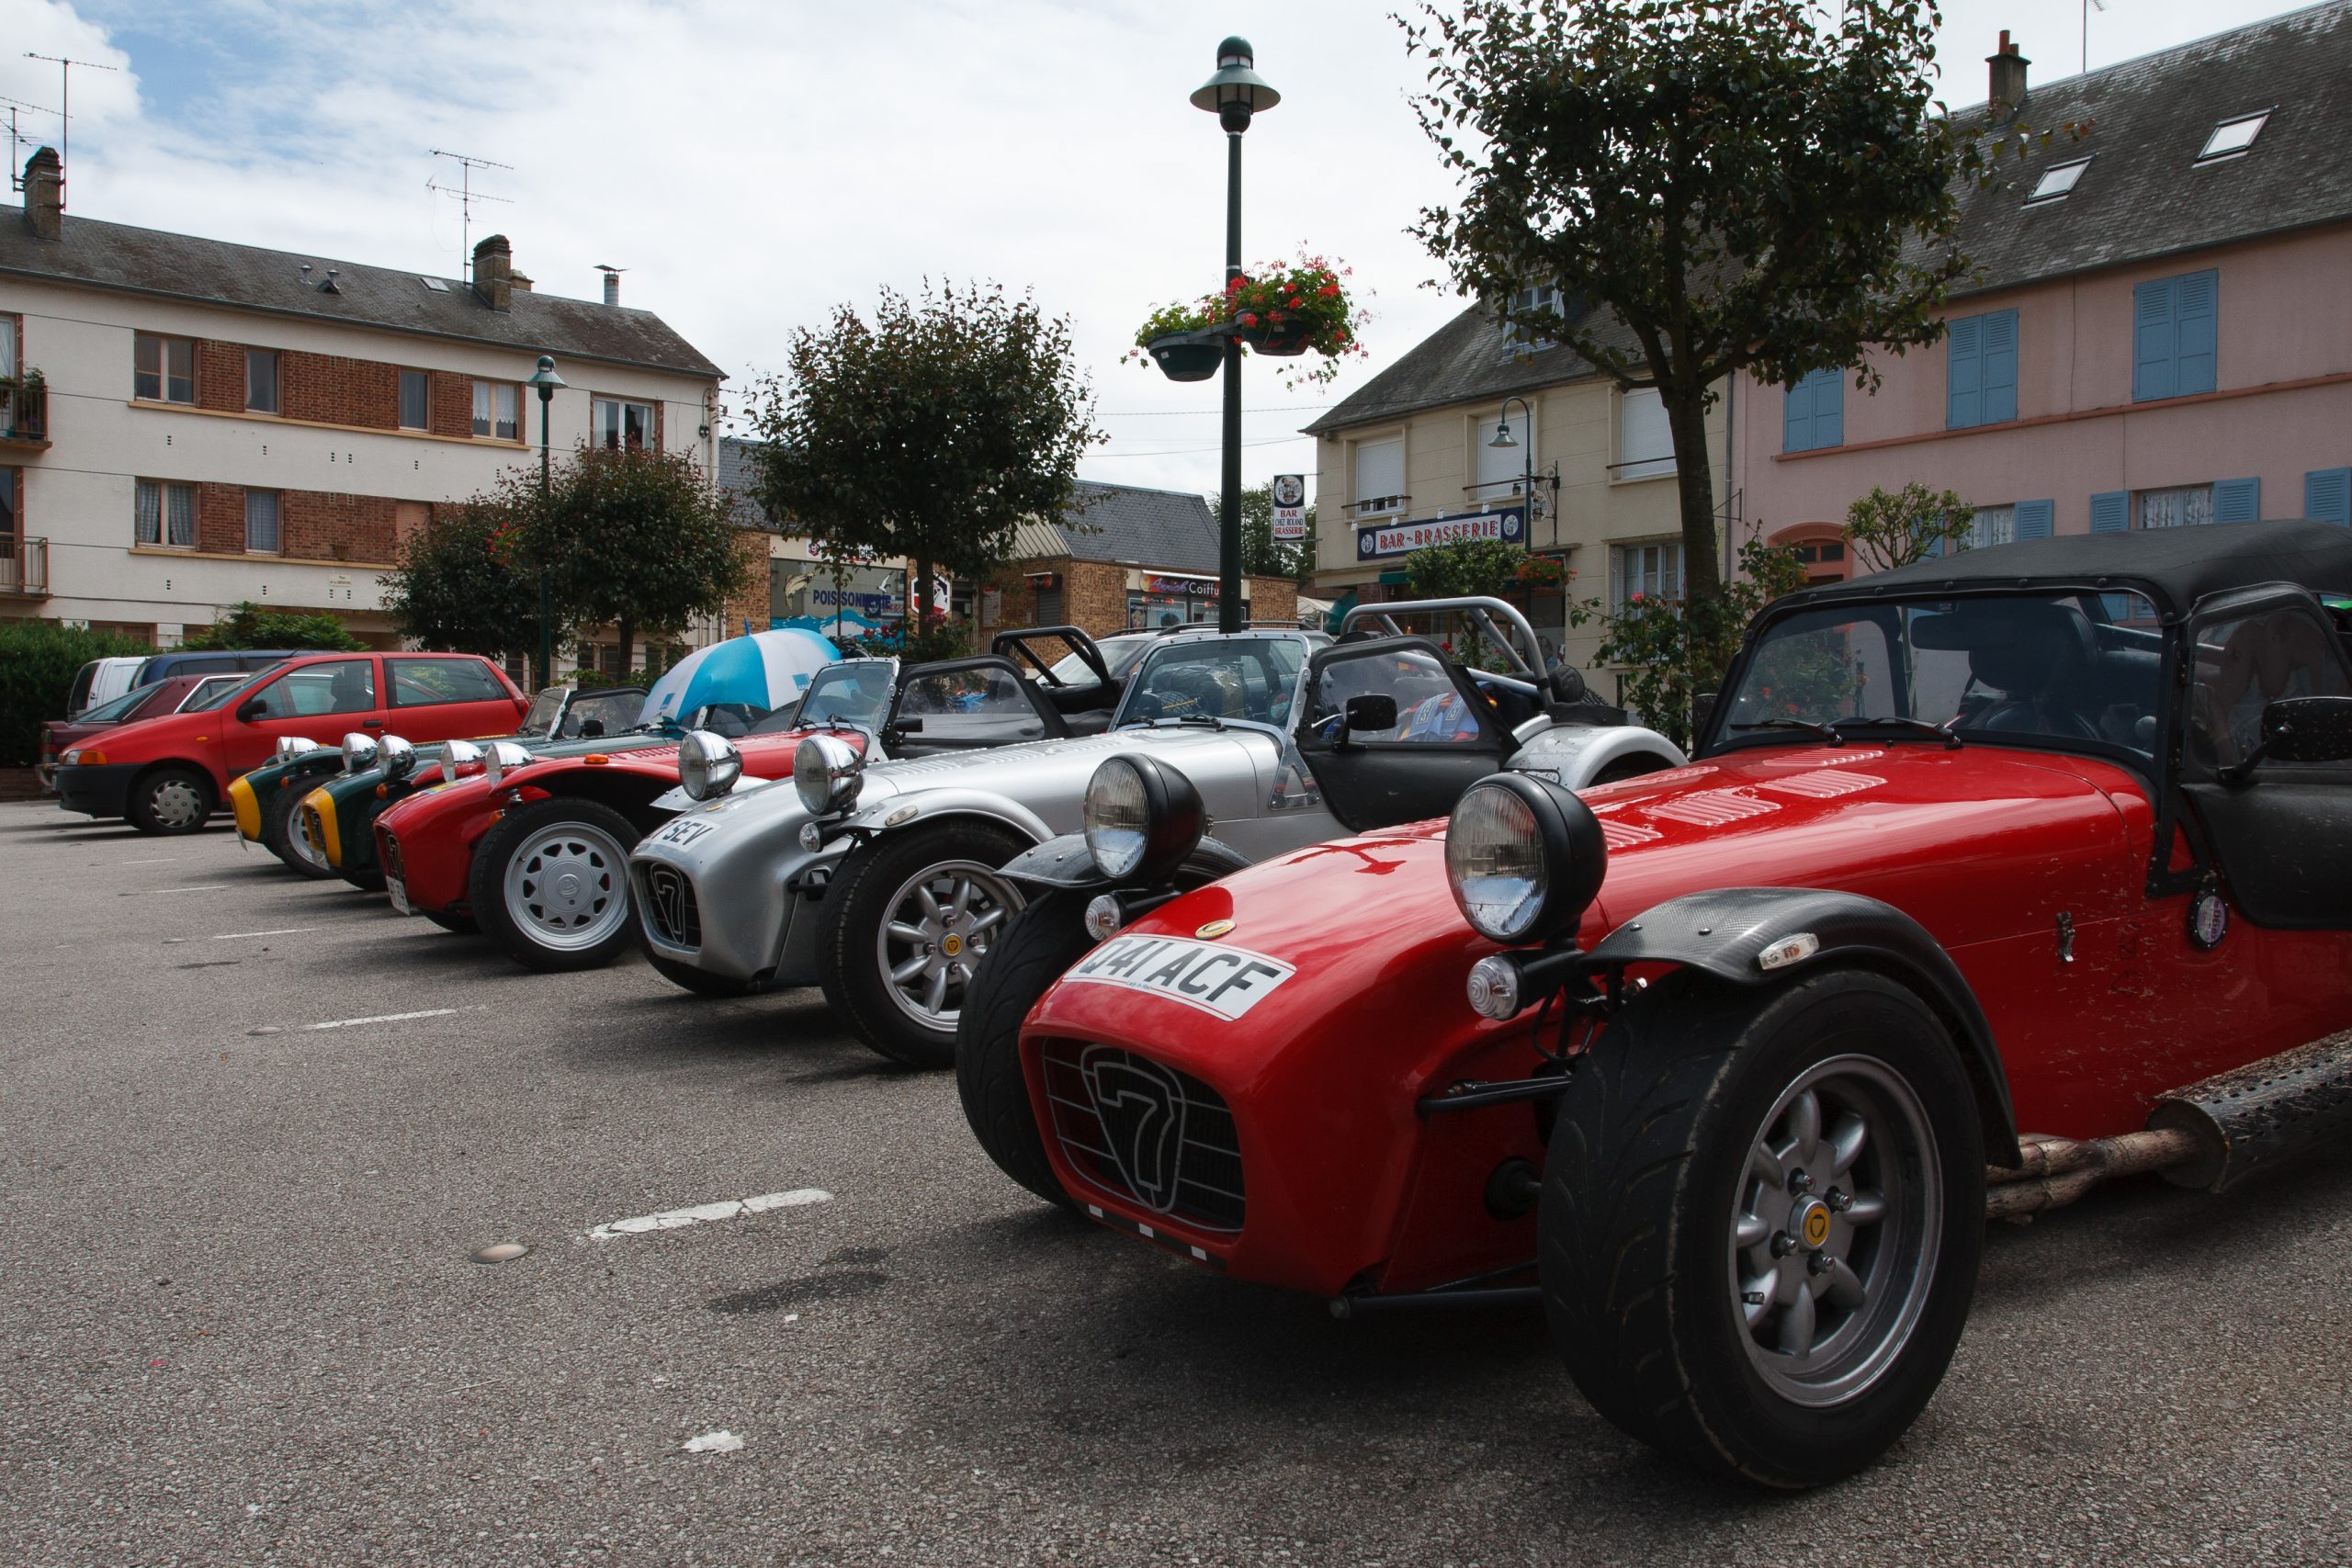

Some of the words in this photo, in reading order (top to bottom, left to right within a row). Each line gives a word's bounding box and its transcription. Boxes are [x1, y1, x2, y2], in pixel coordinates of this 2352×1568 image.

[1280, 510, 1297, 518] BAR
[1189, 581, 1220, 596] Coiffu
[813, 590, 892, 609] POISSONIE
[1144, 947, 1282, 1002] ACF
